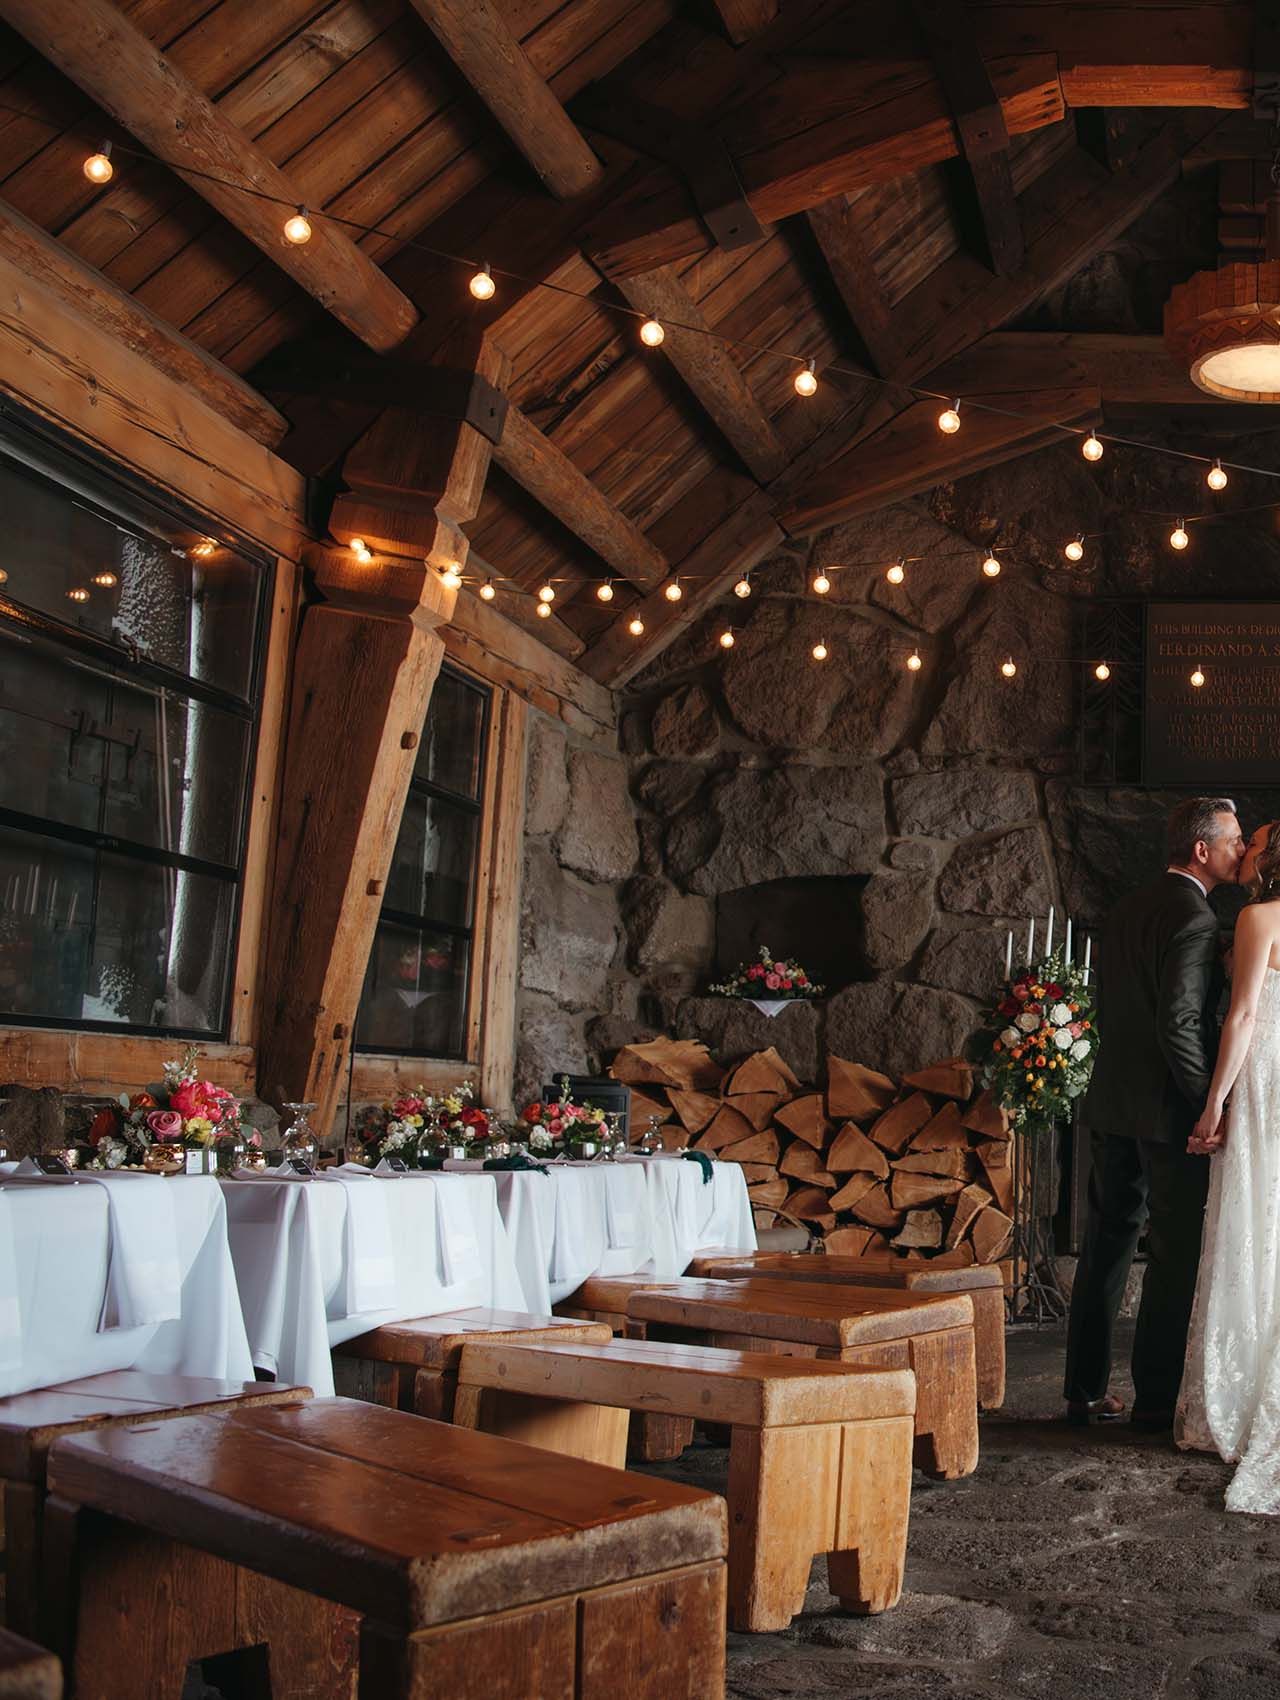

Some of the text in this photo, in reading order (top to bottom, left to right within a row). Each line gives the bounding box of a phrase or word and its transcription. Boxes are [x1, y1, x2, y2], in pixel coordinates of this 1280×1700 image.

[1152, 624, 1178, 634] THIS
[1181, 624, 1234, 634] BUILDING
[1238, 624, 1247, 634] IS
[1159, 643, 1253, 656] FERDINAND
